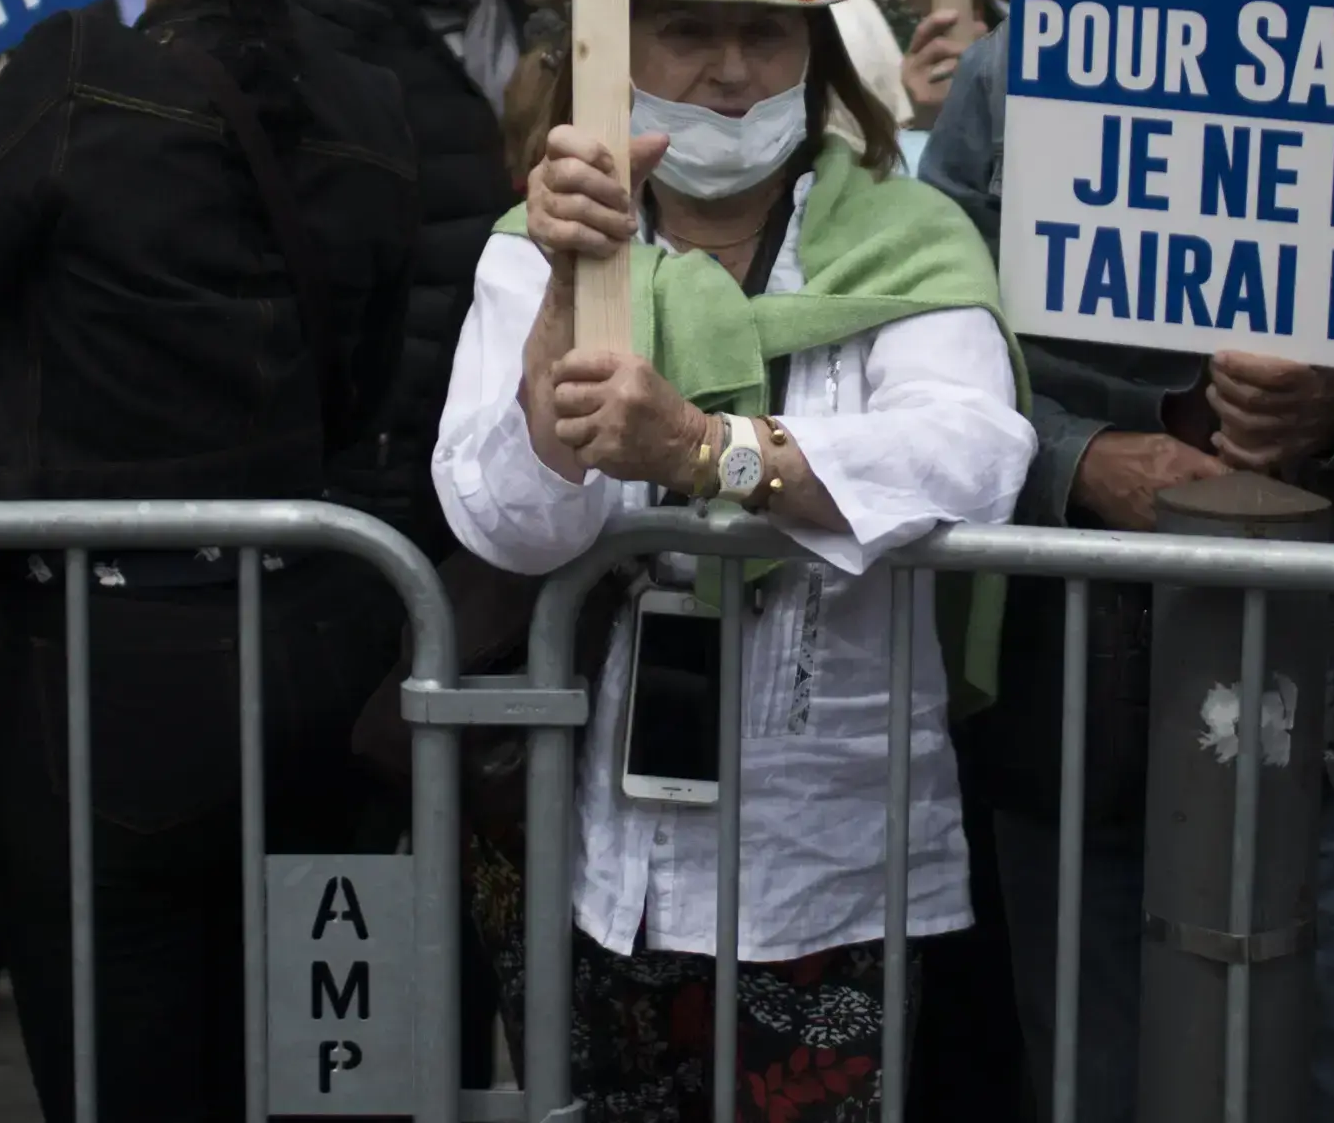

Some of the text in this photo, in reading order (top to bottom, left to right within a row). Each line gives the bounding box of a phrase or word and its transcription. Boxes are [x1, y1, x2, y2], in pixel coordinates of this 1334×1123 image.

[1073, 114, 1173, 211] JE
[1199, 123, 1303, 223] NE
[1035, 220, 1299, 336] TAIRAI
